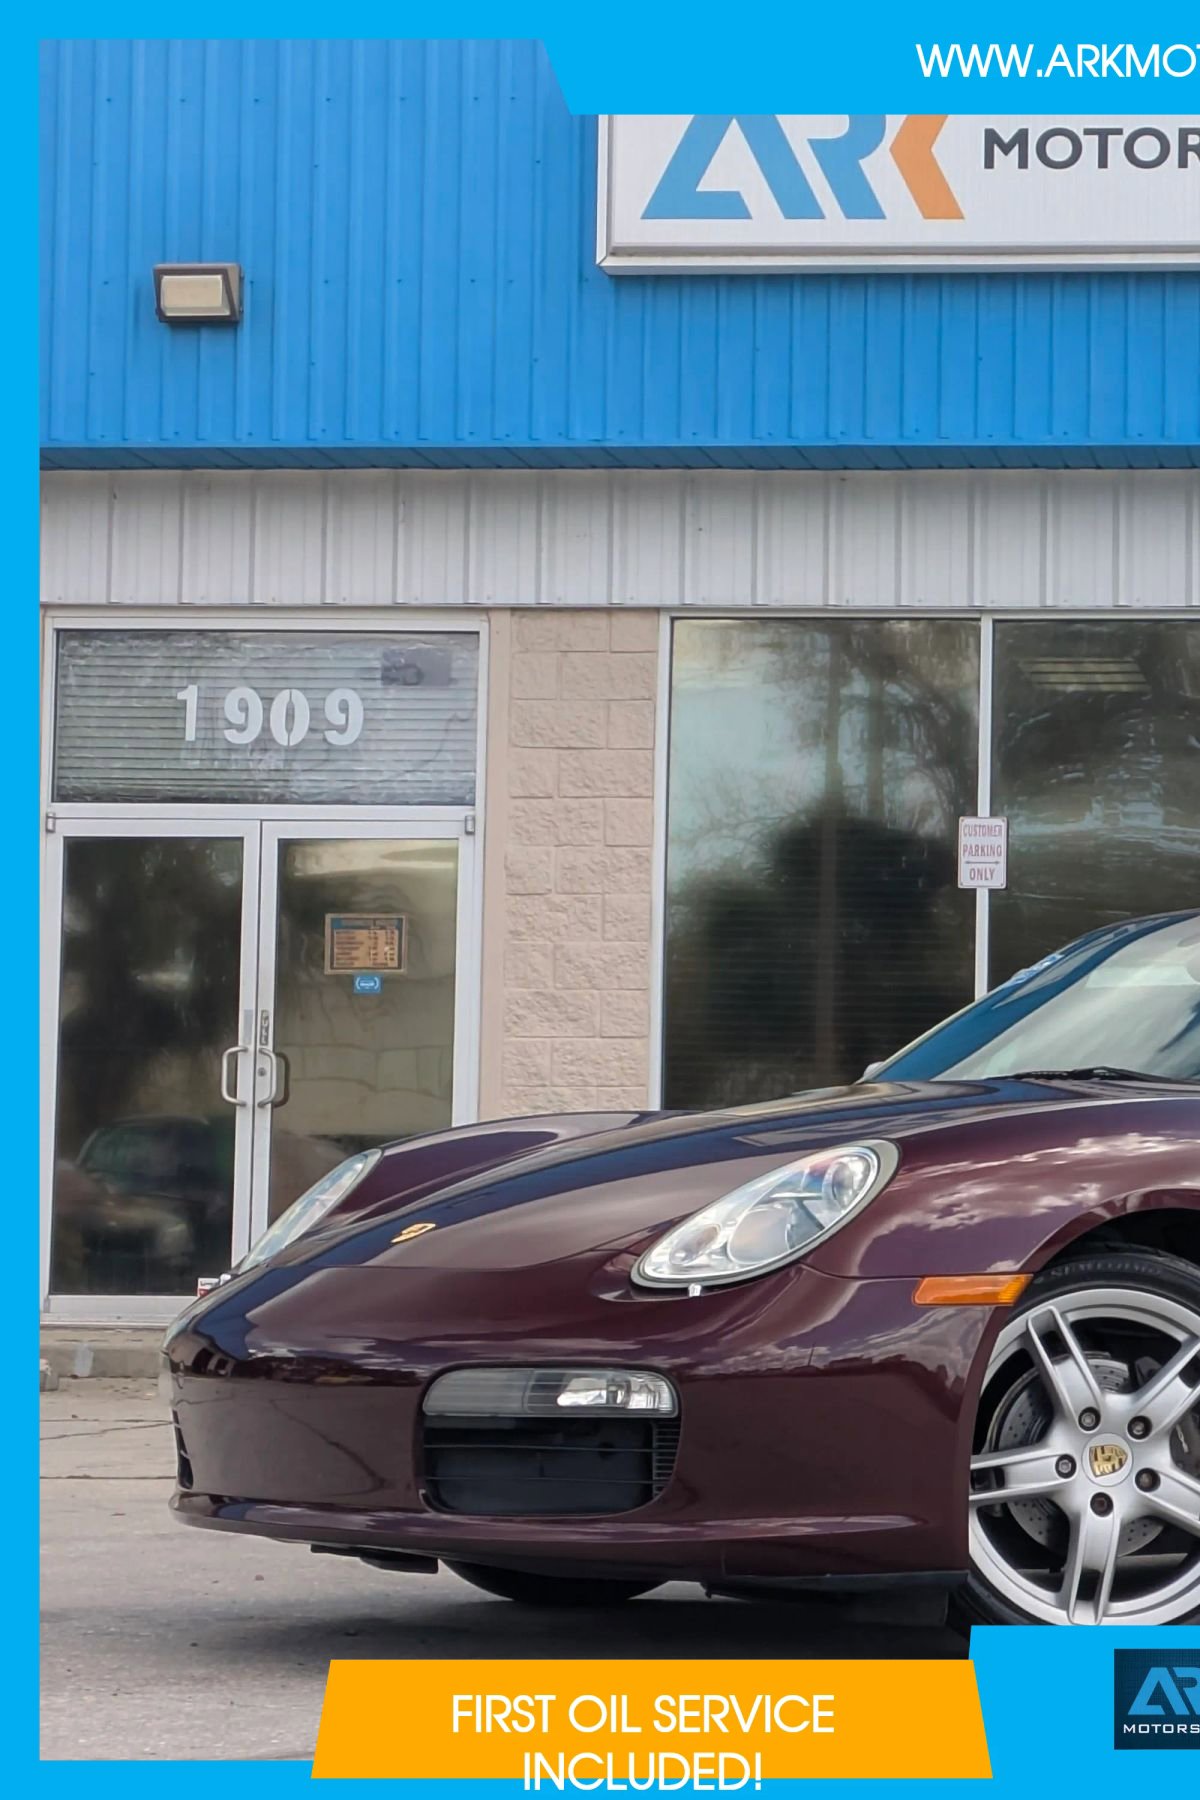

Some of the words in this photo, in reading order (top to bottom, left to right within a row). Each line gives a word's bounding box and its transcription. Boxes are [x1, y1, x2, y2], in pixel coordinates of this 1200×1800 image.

[176, 684, 365, 747] 1909
[963, 824, 1003, 837] CUSTOMER
[962, 844, 1003, 857] PARKING
[969, 867, 996, 881] ONLY
